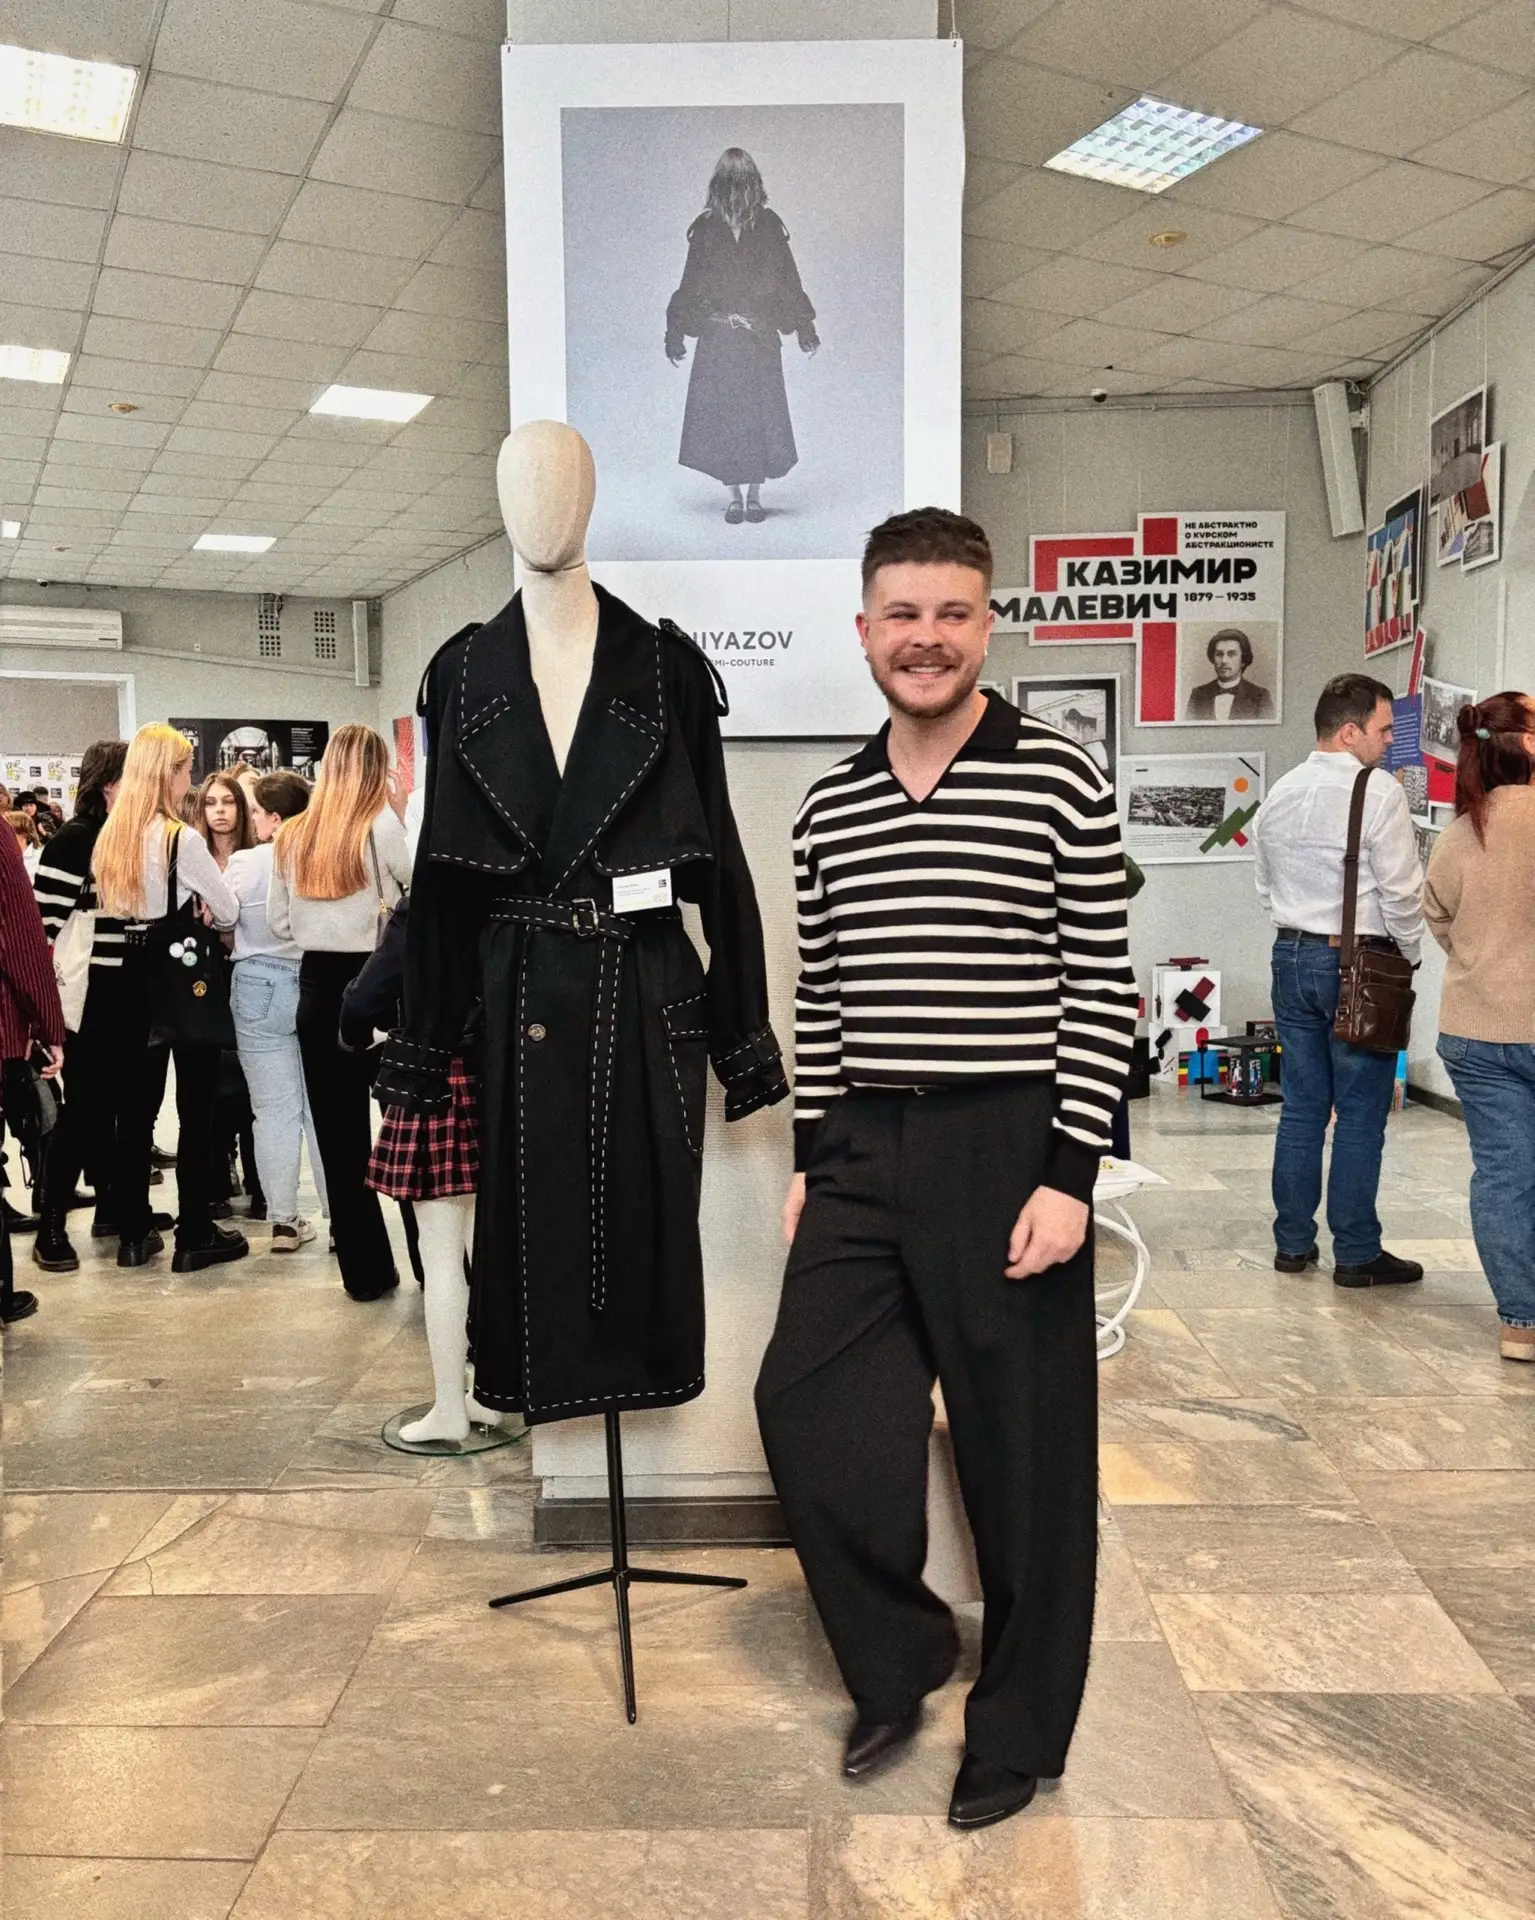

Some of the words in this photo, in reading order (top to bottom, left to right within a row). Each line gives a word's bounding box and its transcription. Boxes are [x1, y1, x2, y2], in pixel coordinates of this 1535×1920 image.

[1198, 521, 1258, 529] АБСТРАКТНО
[1193, 531, 1238, 539] КУРСКОМ
[1185, 541, 1274, 549] АБСТРАКЦИОНИСТЕ
[1067, 558, 1257, 587] КАЗИМИР
[1184, 592, 1213, 601] 1879
[1226, 592, 1256, 601] 1935
[989, 593, 1177, 622] МАЛЕВИЧ
[711, 658, 775, 667] MI-COUTURE
